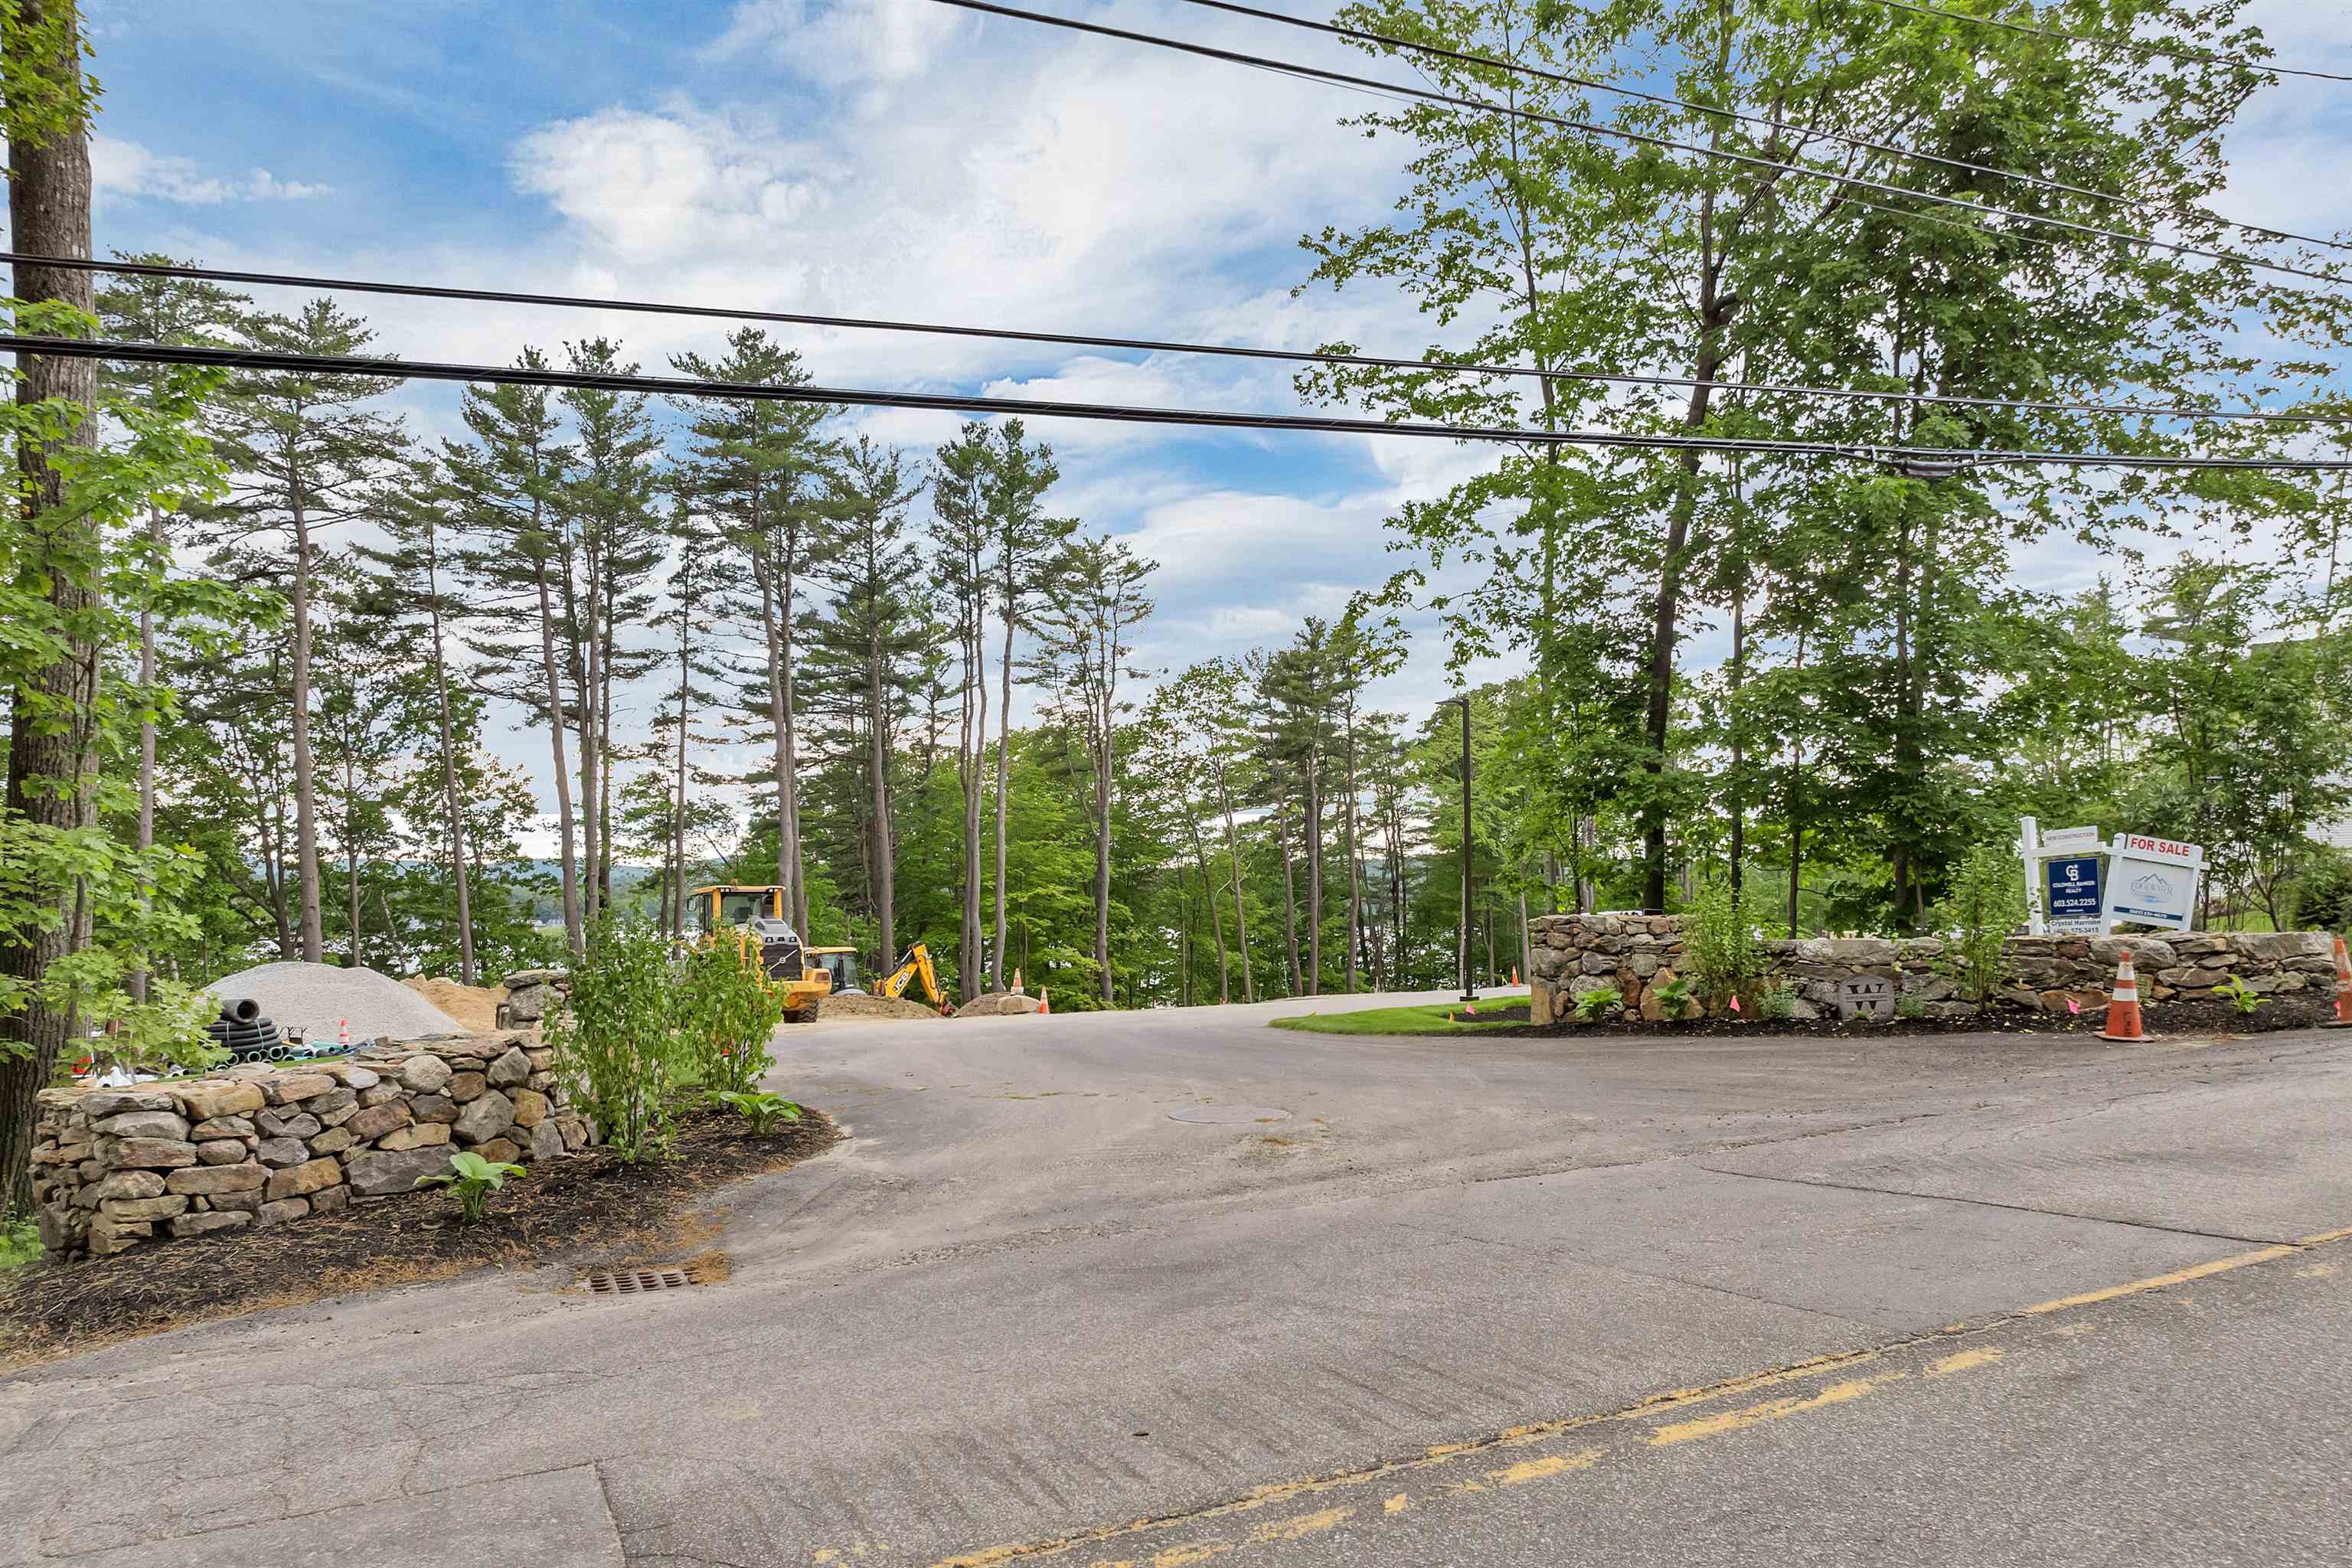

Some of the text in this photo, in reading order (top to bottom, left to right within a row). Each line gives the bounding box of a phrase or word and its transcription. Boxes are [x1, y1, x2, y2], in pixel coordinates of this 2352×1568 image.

[2131, 838, 2190, 857] FOR SALE
[2053, 898, 2096, 907] 603.524.2255
[895, 972, 907, 992] JCB
[1847, 984, 1884, 1011] W
